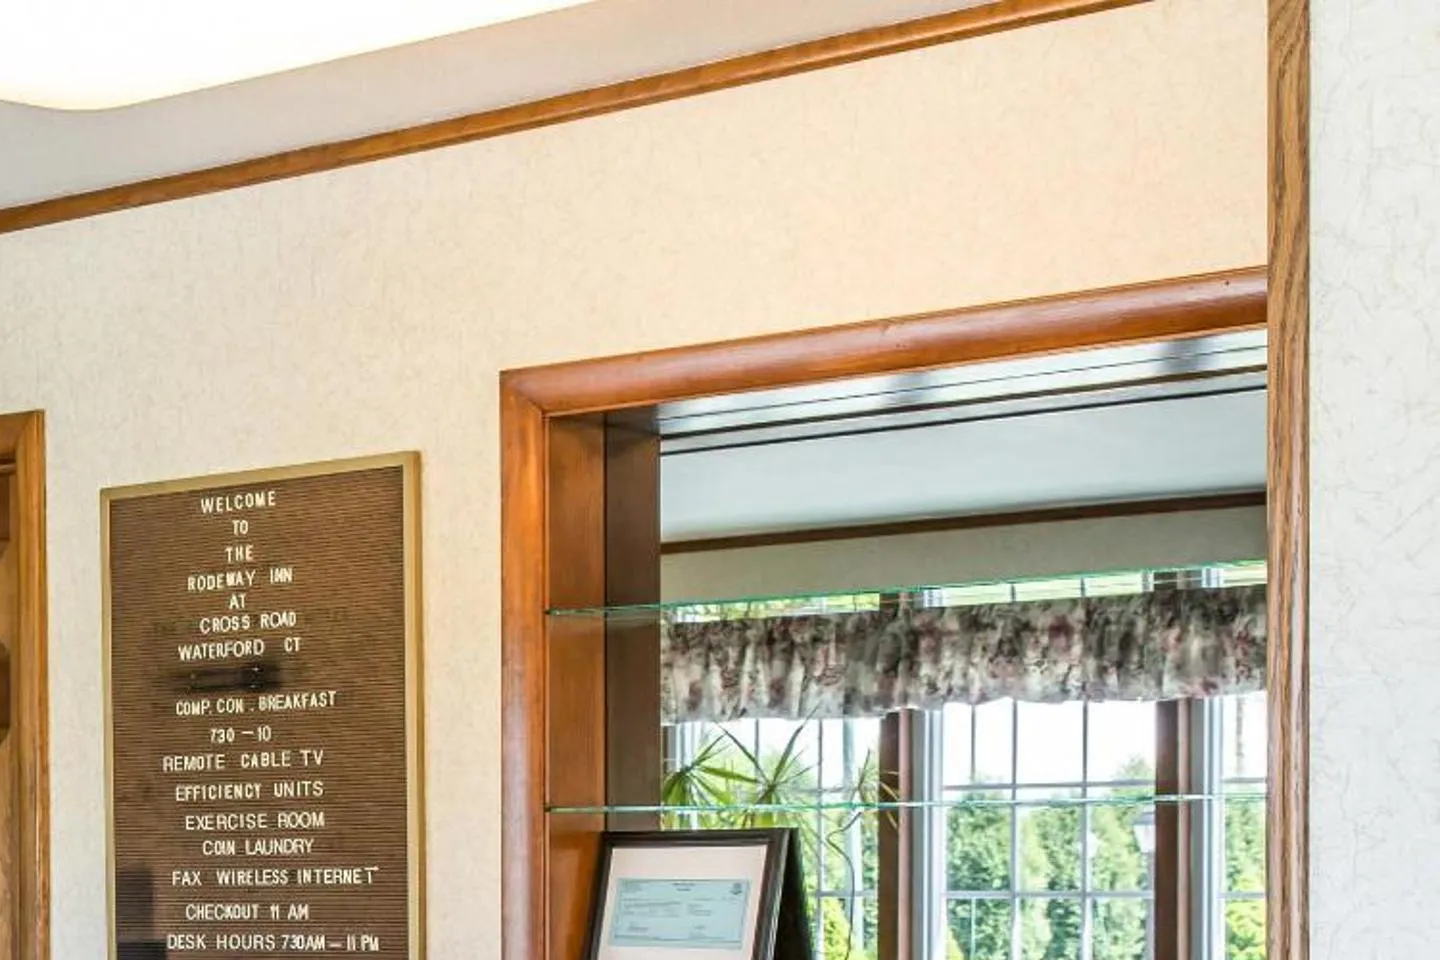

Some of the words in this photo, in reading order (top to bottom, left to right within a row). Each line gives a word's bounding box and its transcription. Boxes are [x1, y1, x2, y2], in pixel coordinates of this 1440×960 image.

[201, 490, 276, 514] WELCOME
[232, 519, 249, 536] TO
[225, 544, 254, 563] THE
[187, 569, 256, 592] RODEWAY
[270, 567, 293, 585] INN
[229, 593, 246, 610] AT
[199, 615, 251, 634] CROSS
[260, 611, 297, 629] ROAD
[178, 638, 265, 661] WATERFORD
[284, 637, 302, 653] CT
[258, 690, 337, 711] BREAKFAST
[210, 727, 235, 744] 730
[257, 725, 272, 742] 10
[163, 753, 225, 772] REMOTE
[241, 751, 291, 768] CABLE
[299, 750, 324, 766] TV
[175, 783, 261, 802] EFFICIENCY
[273, 780, 324, 798] UNITS
[185, 813, 267, 831] EXERCISE
[277, 811, 325, 828] ROOM
[202, 840, 235, 856] COIN
[245, 838, 314, 855] LAUNDRY
[172, 870, 202, 886] FAX
[216, 868, 288, 885] WIRELESS
[297, 866, 379, 885] INTERNET
[185, 903, 259, 921] CHECKOUT
[270, 904, 280, 920] 11
[287, 903, 310, 920] AM
[167, 934, 206, 950] DESK
[216, 933, 276, 950] HOURS
[361, 934, 380, 951] PM
